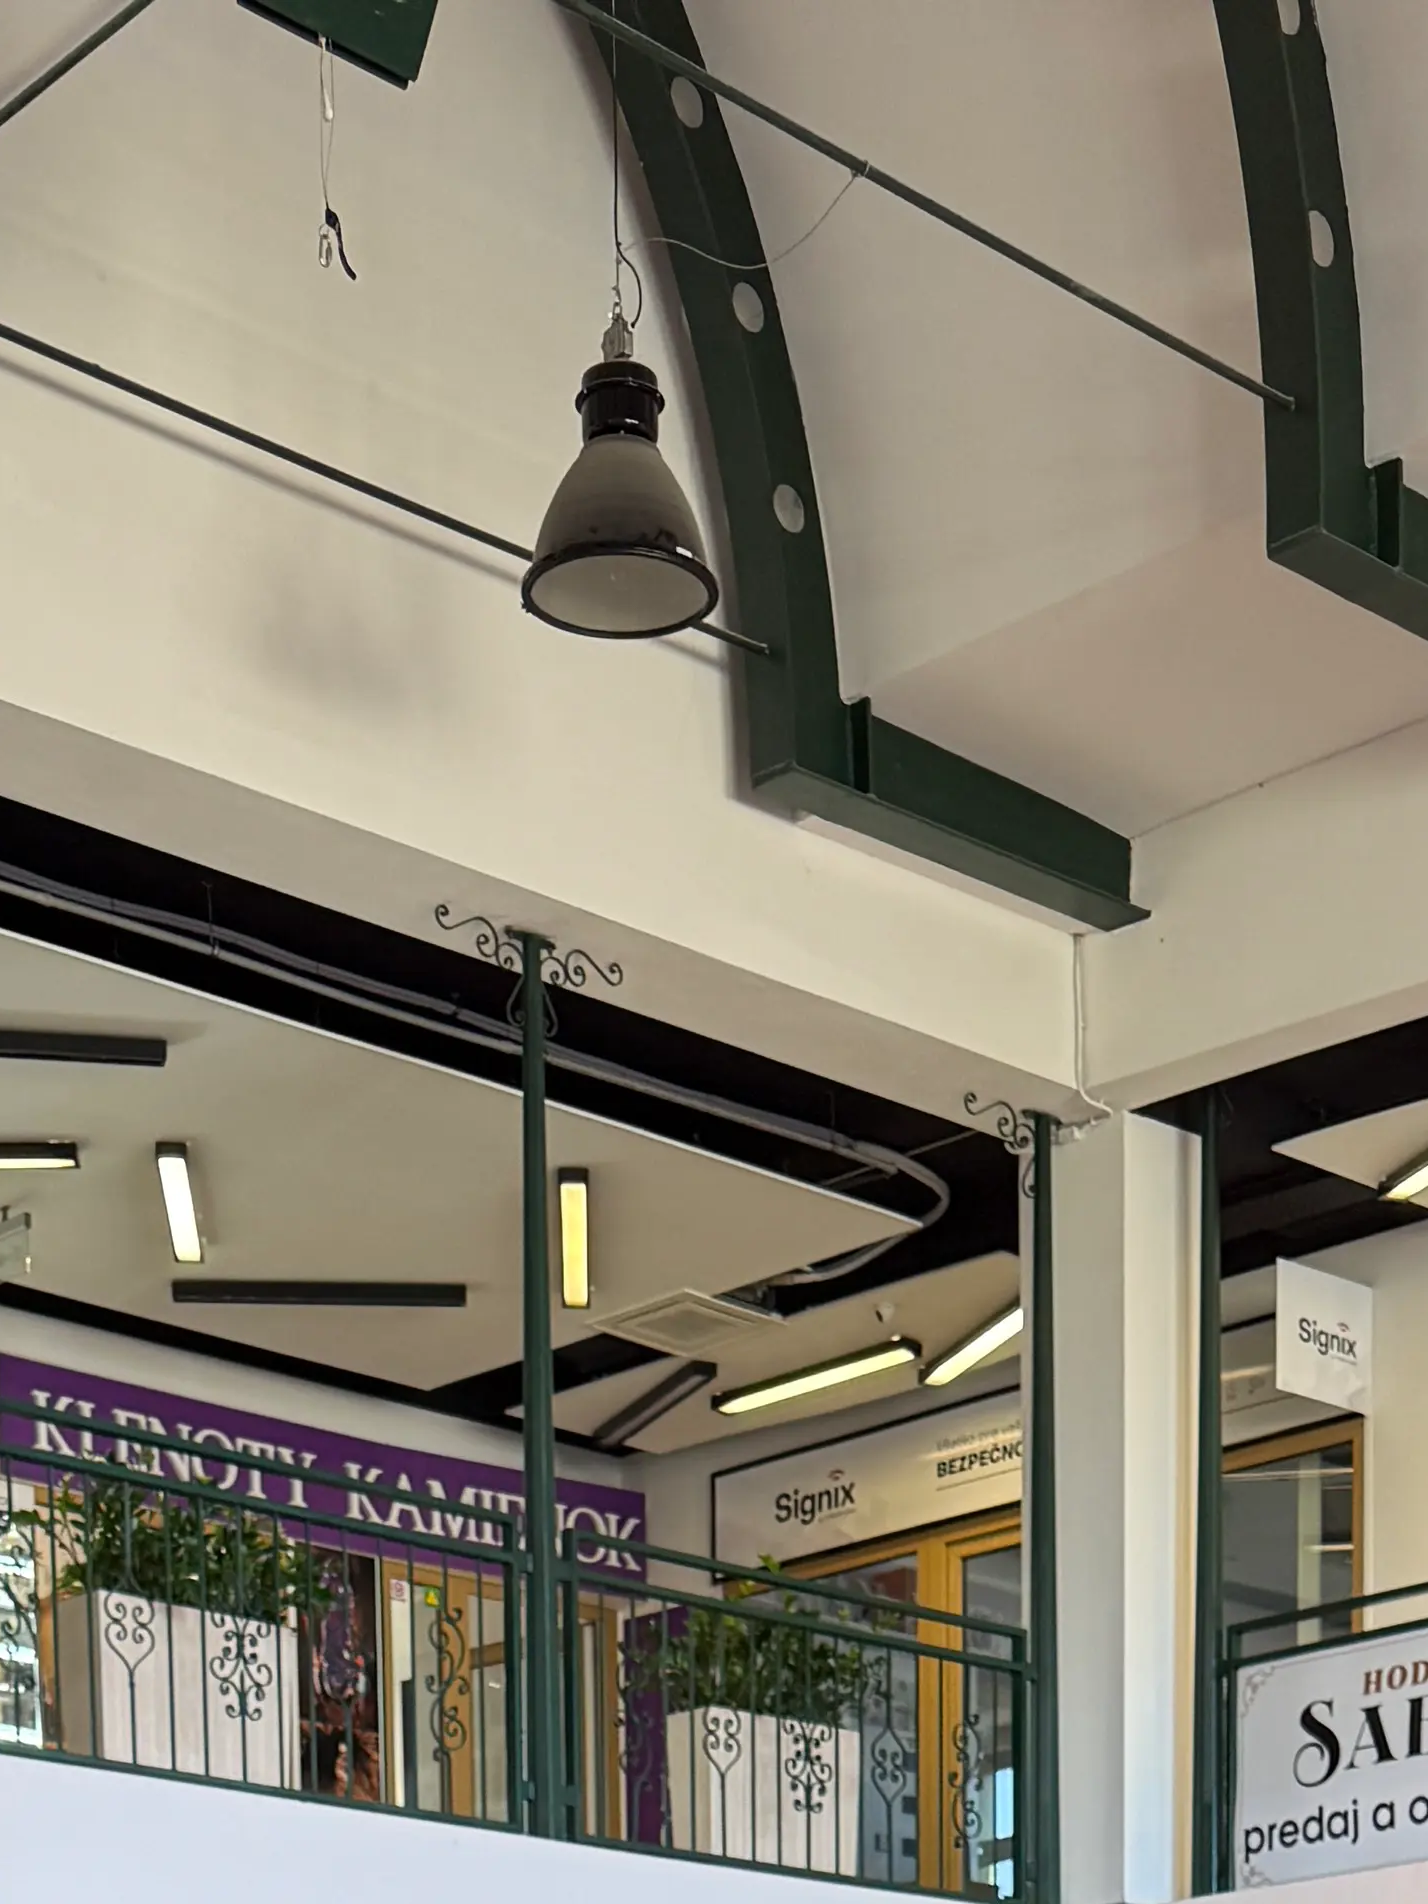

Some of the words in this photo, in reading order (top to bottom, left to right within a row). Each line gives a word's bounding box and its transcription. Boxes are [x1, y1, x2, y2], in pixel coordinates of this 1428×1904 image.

[1298, 1317, 1357, 1359] Signix
[774, 1480, 856, 1525] Signix
[1243, 1798, 1360, 1864] predaj
[1372, 1801, 1396, 1830] a
